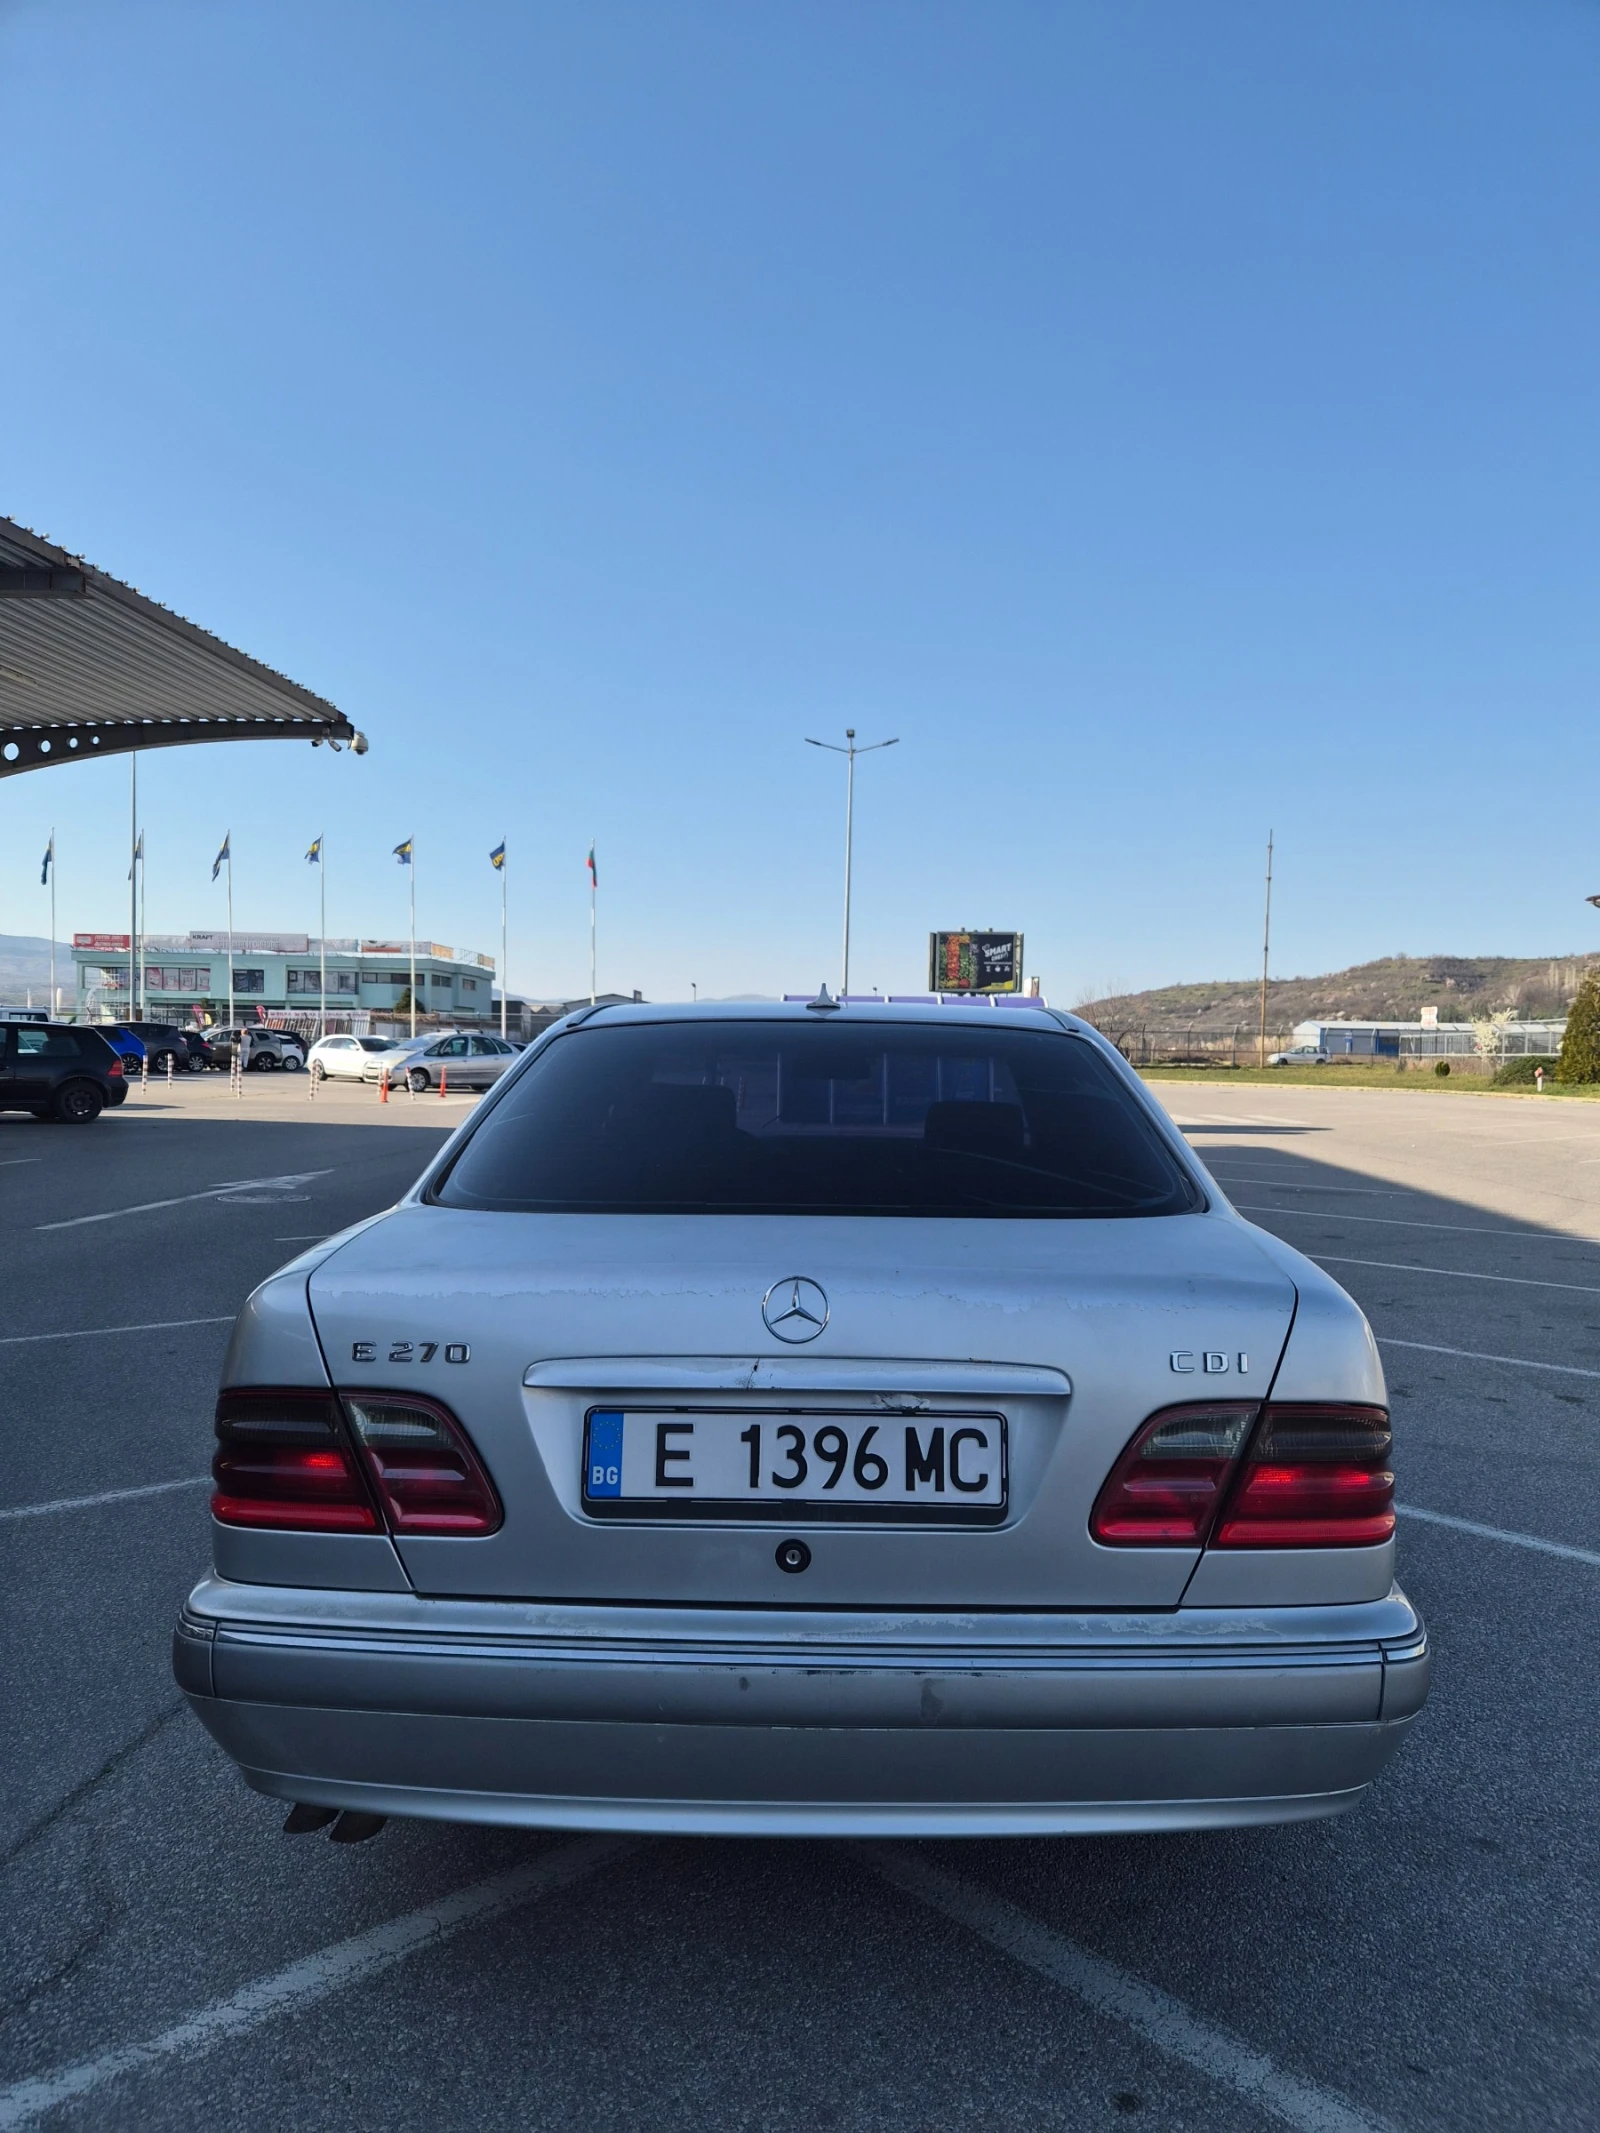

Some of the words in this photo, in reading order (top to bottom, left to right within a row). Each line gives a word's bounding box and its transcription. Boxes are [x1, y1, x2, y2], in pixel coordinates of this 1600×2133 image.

[984, 943, 1012, 958] SMART
[352, 1340, 377, 1362] E
[388, 1341, 472, 1364] 270
[1169, 1350, 1249, 1374] CDI
[654, 1423, 695, 1488] E
[740, 1423, 890, 1491] 1396
[904, 1426, 989, 1493] MC
[591, 1465, 619, 1486] BG
